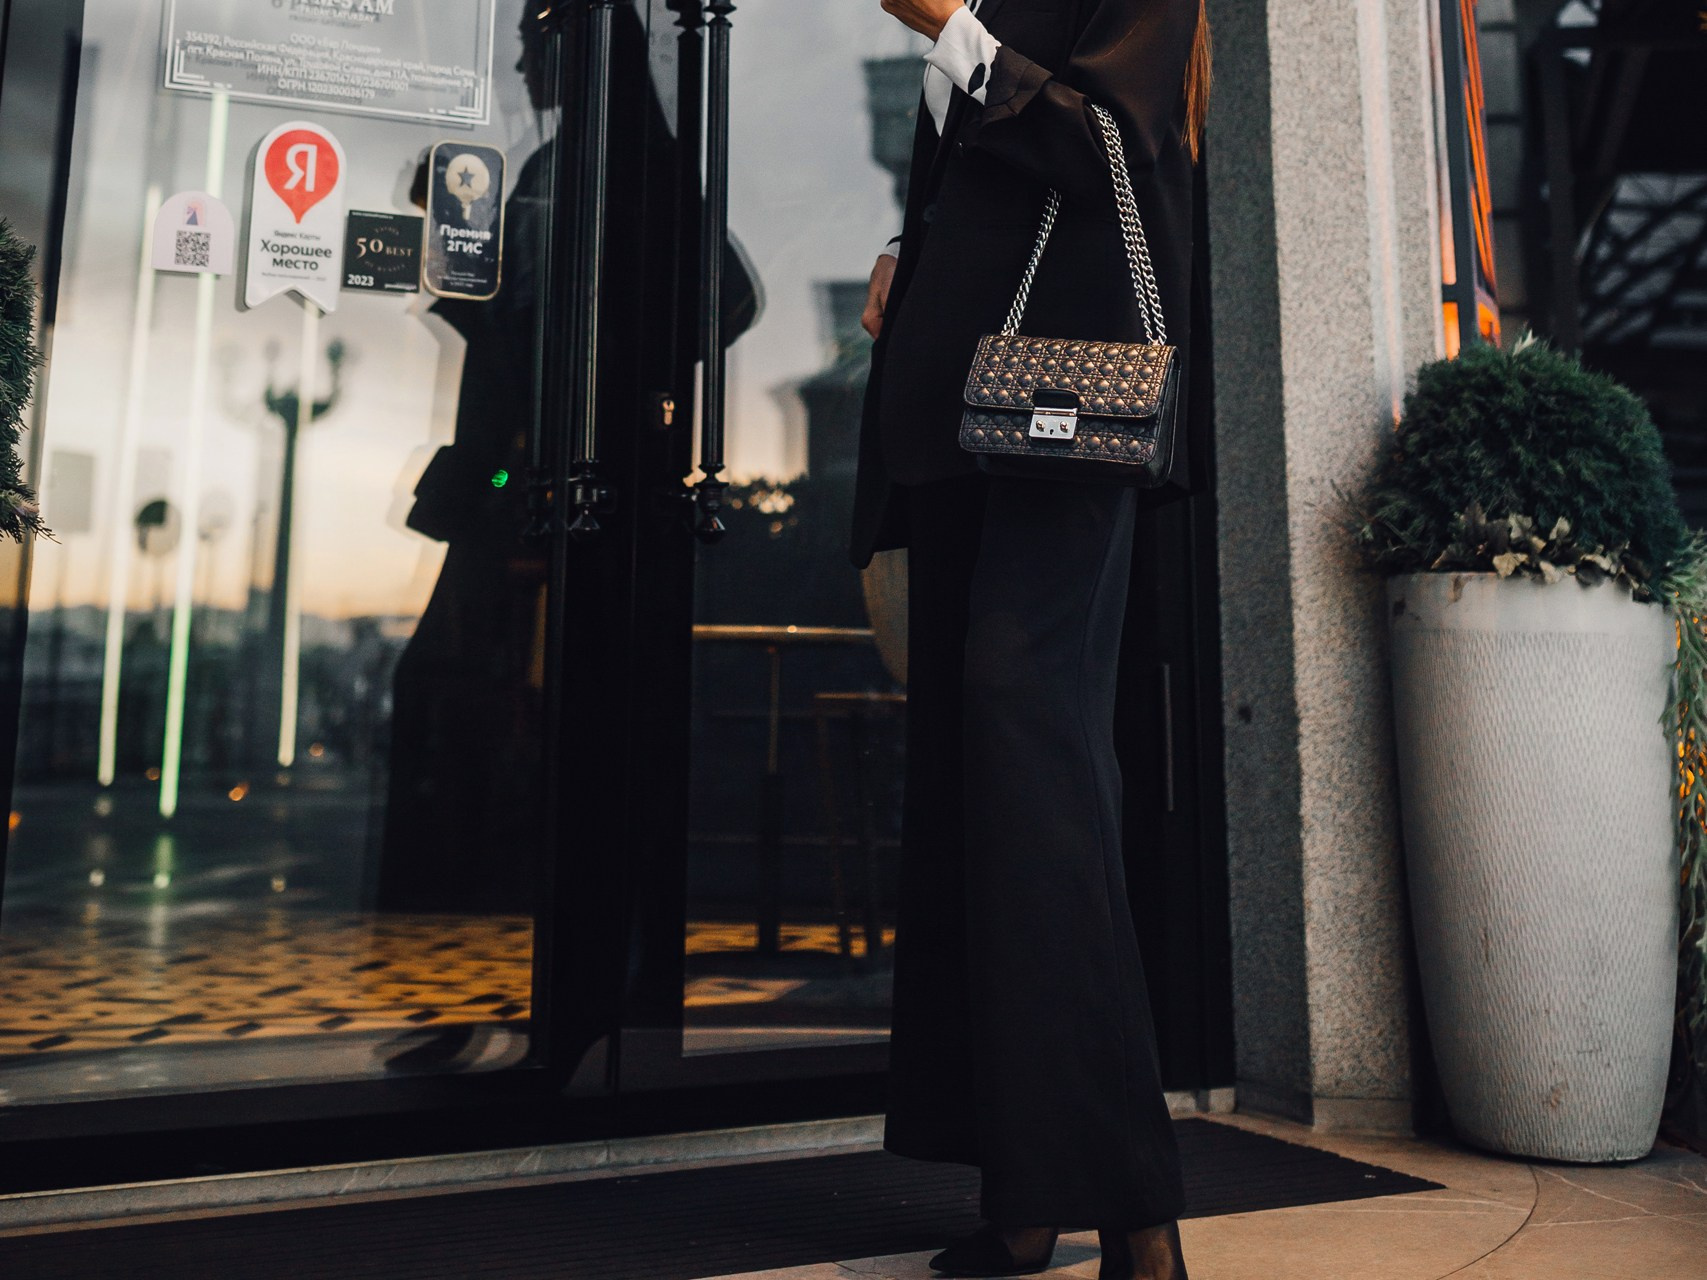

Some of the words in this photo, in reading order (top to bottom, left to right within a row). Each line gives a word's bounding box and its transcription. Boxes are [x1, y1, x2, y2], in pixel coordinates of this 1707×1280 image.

[283, 142, 318, 193] Я
[440, 223, 493, 241] Премия
[260, 238, 333, 259] Хорошее
[356, 236, 384, 261] 50
[385, 246, 414, 258] BEST
[446, 239, 483, 255] 2ГИС
[271, 257, 319, 272] место
[347, 273, 375, 288] 2023
